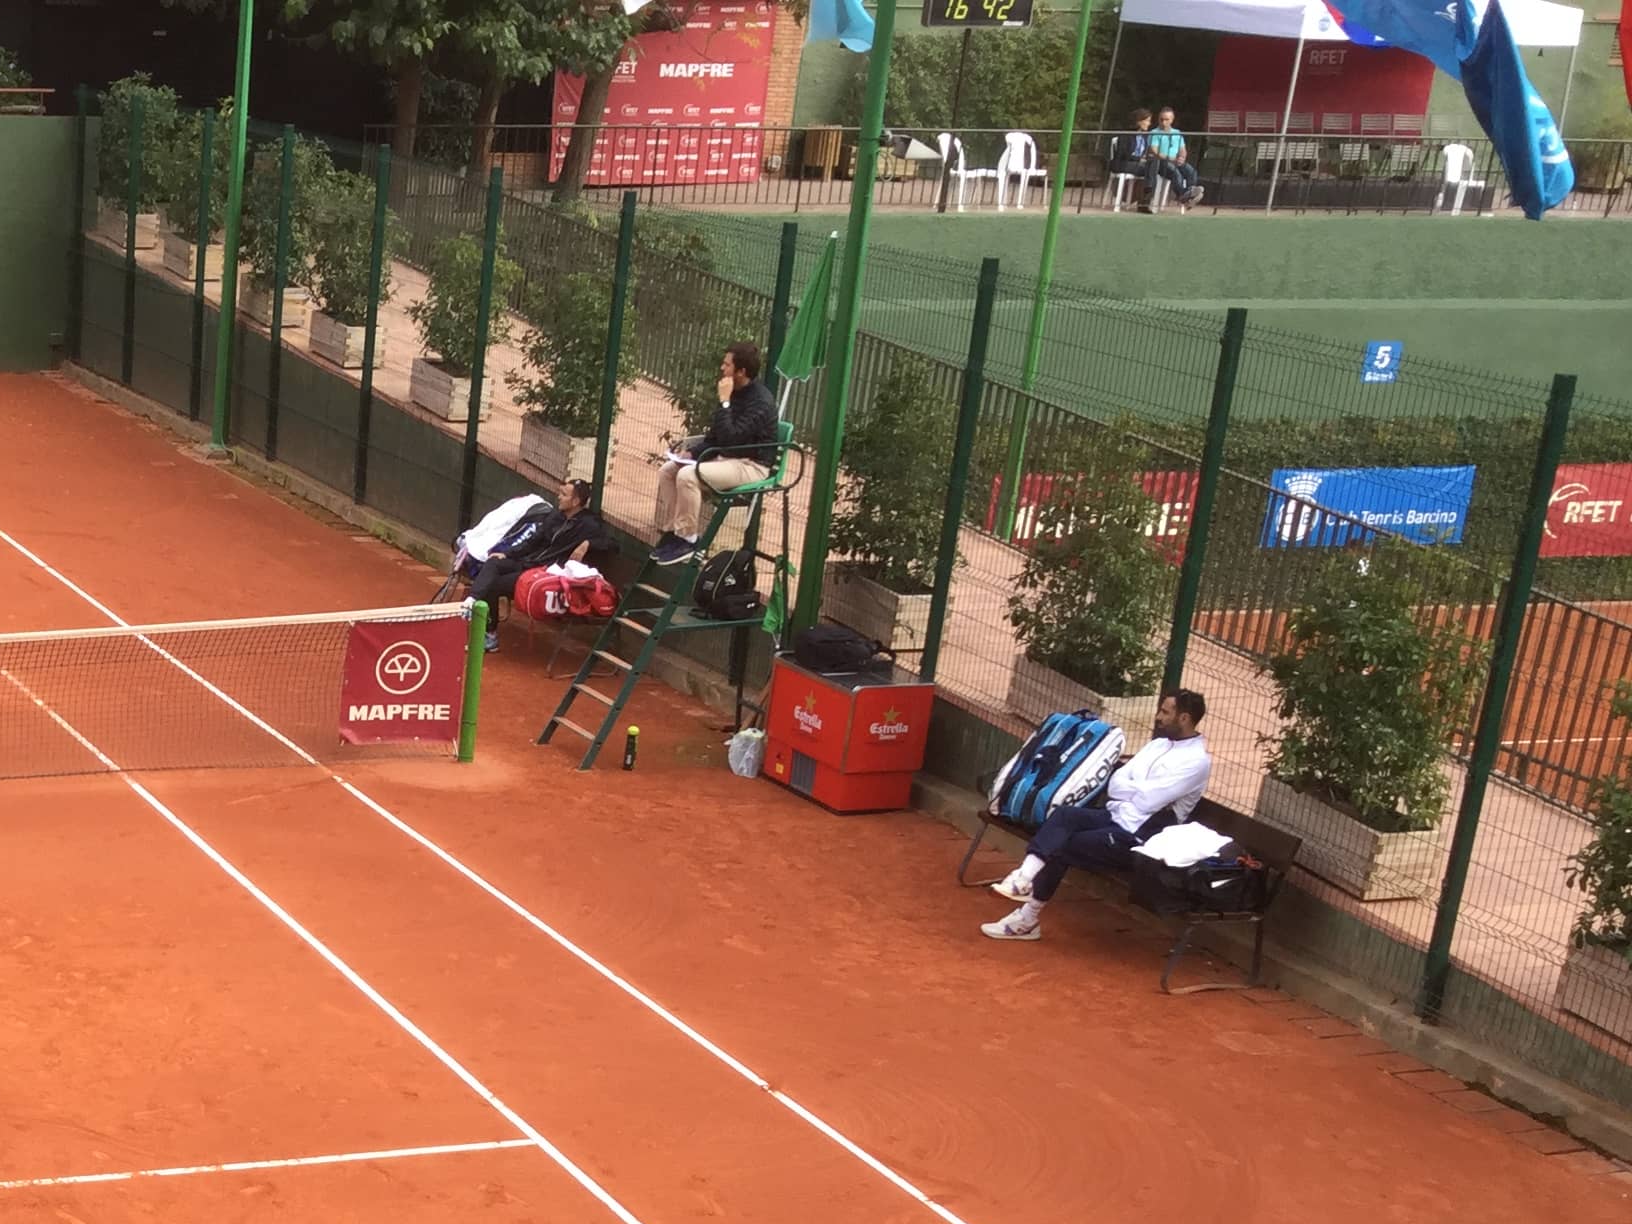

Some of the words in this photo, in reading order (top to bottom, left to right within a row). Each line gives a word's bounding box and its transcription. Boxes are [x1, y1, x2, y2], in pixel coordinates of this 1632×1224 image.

[945, 0, 968, 19] 16
[983, 0, 1014, 19] 42
[1309, 50, 1347, 65] RFET
[614, 61, 638, 75] FET
[659, 63, 734, 78] MAPFRE
[1373, 345, 1393, 370] 5
[1406, 509, 1457, 525] Barcino
[1563, 500, 1623, 523] RFET
[348, 703, 450, 721] MAPFRE
[870, 722, 909, 735] Estrella
